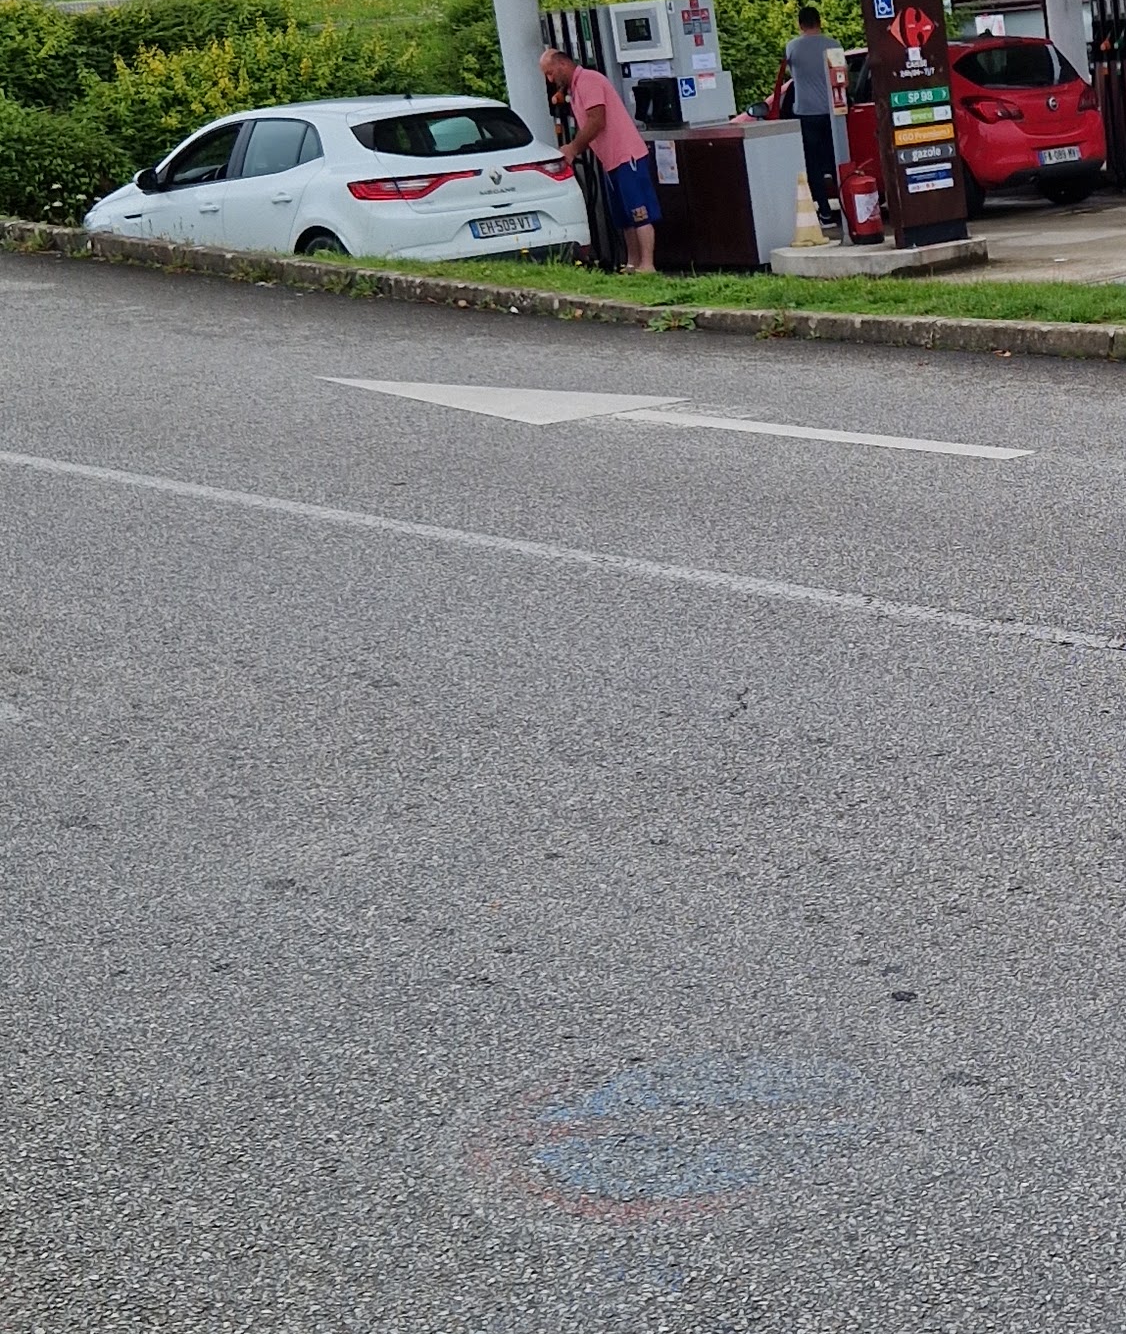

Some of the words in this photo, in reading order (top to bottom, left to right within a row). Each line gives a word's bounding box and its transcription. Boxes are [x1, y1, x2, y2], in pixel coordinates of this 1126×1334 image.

[907, 92, 920, 103] SP
[920, 90, 933, 102] 98
[912, 146, 941, 162] gazole
